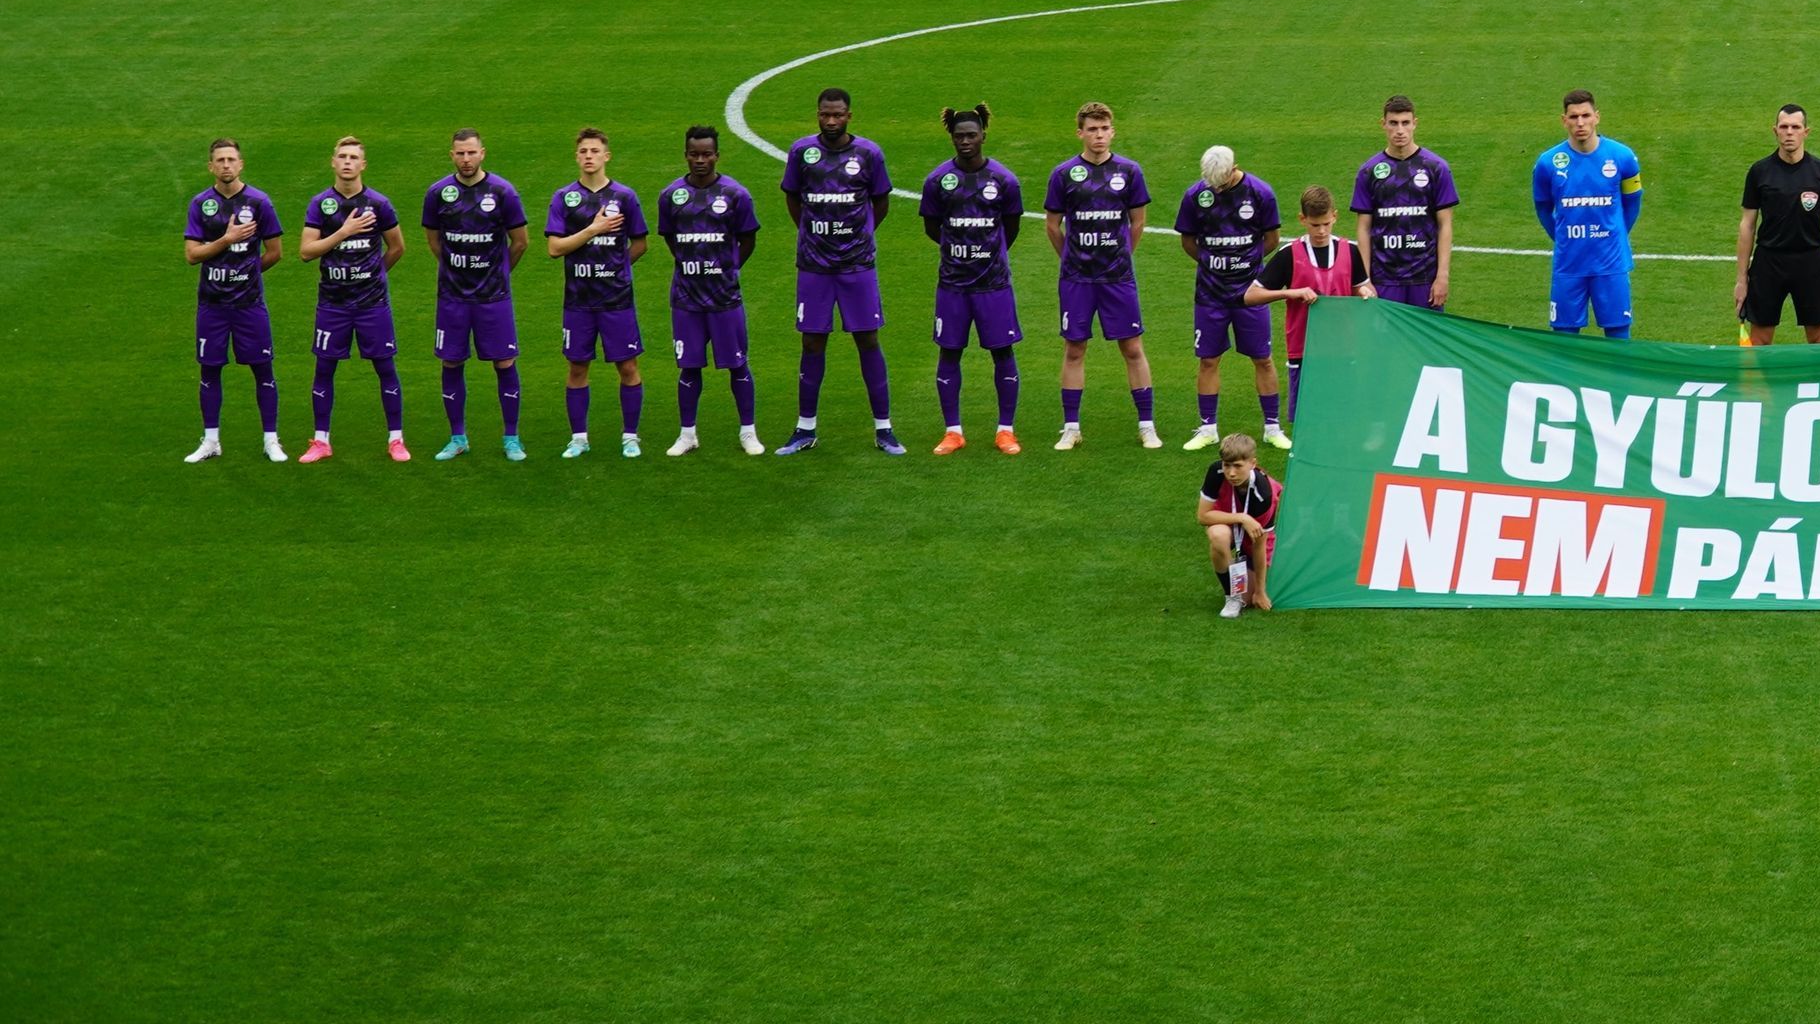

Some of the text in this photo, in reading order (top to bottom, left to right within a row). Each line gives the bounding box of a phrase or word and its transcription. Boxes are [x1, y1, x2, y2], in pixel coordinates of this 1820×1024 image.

[812, 221, 829, 235] 101
[1567, 224, 1586, 239] 101
[1079, 232, 1097, 247] 101
[1383, 234, 1402, 249] 101
[950, 244, 967, 259] 101
[450, 253, 467, 268] 101
[1209, 255, 1227, 271] 101
[208, 266, 226, 283] 101
[328, 266, 347, 280] 101
[574, 263, 591, 278] 101
[682, 261, 700, 276] 101
[1062, 311, 1069, 331] 6
[1392, 366, 1469, 474] A
[1369, 485, 1653, 597] NEM
